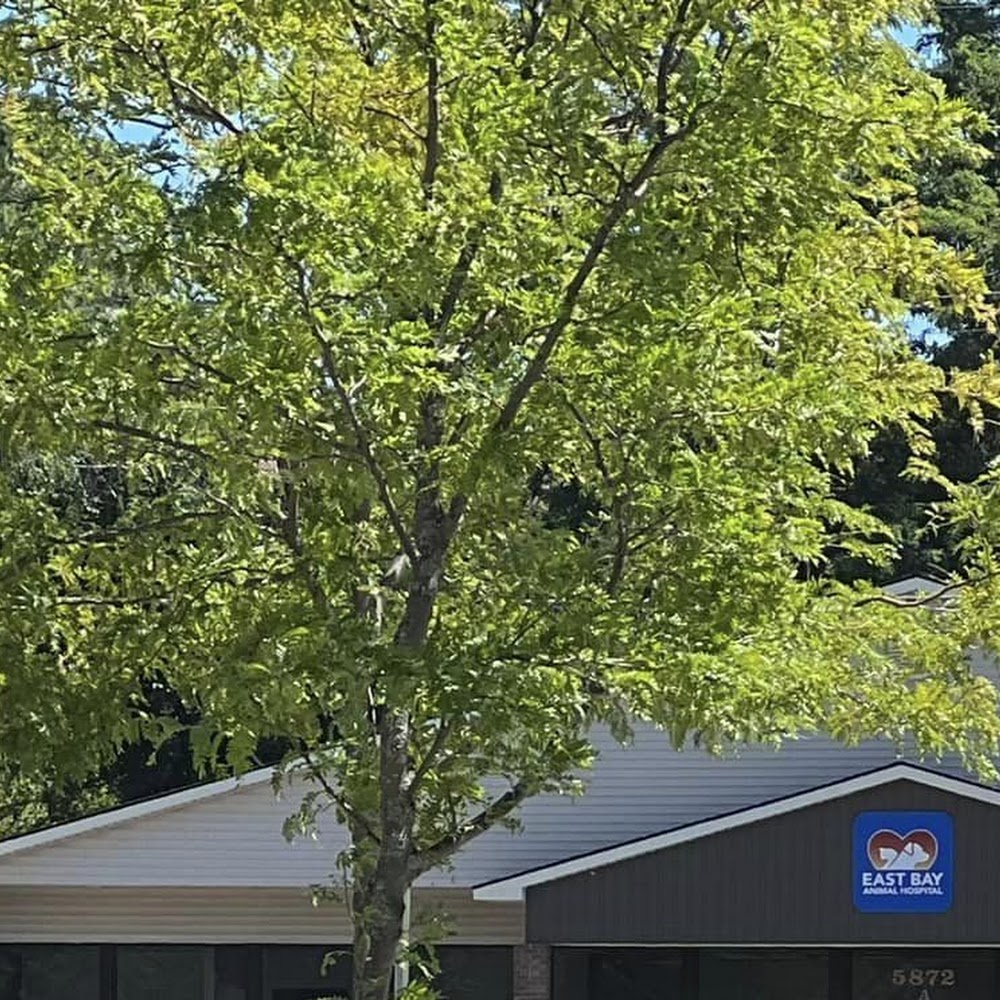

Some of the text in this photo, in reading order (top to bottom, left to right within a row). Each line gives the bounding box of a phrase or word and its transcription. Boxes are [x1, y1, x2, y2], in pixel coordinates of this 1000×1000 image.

[862, 872, 944, 886] EAST BAY
[862, 887, 944, 895] ANIMAL HOSPITAL
[892, 969, 956, 986] 5872
[919, 989, 930, 1000] A
